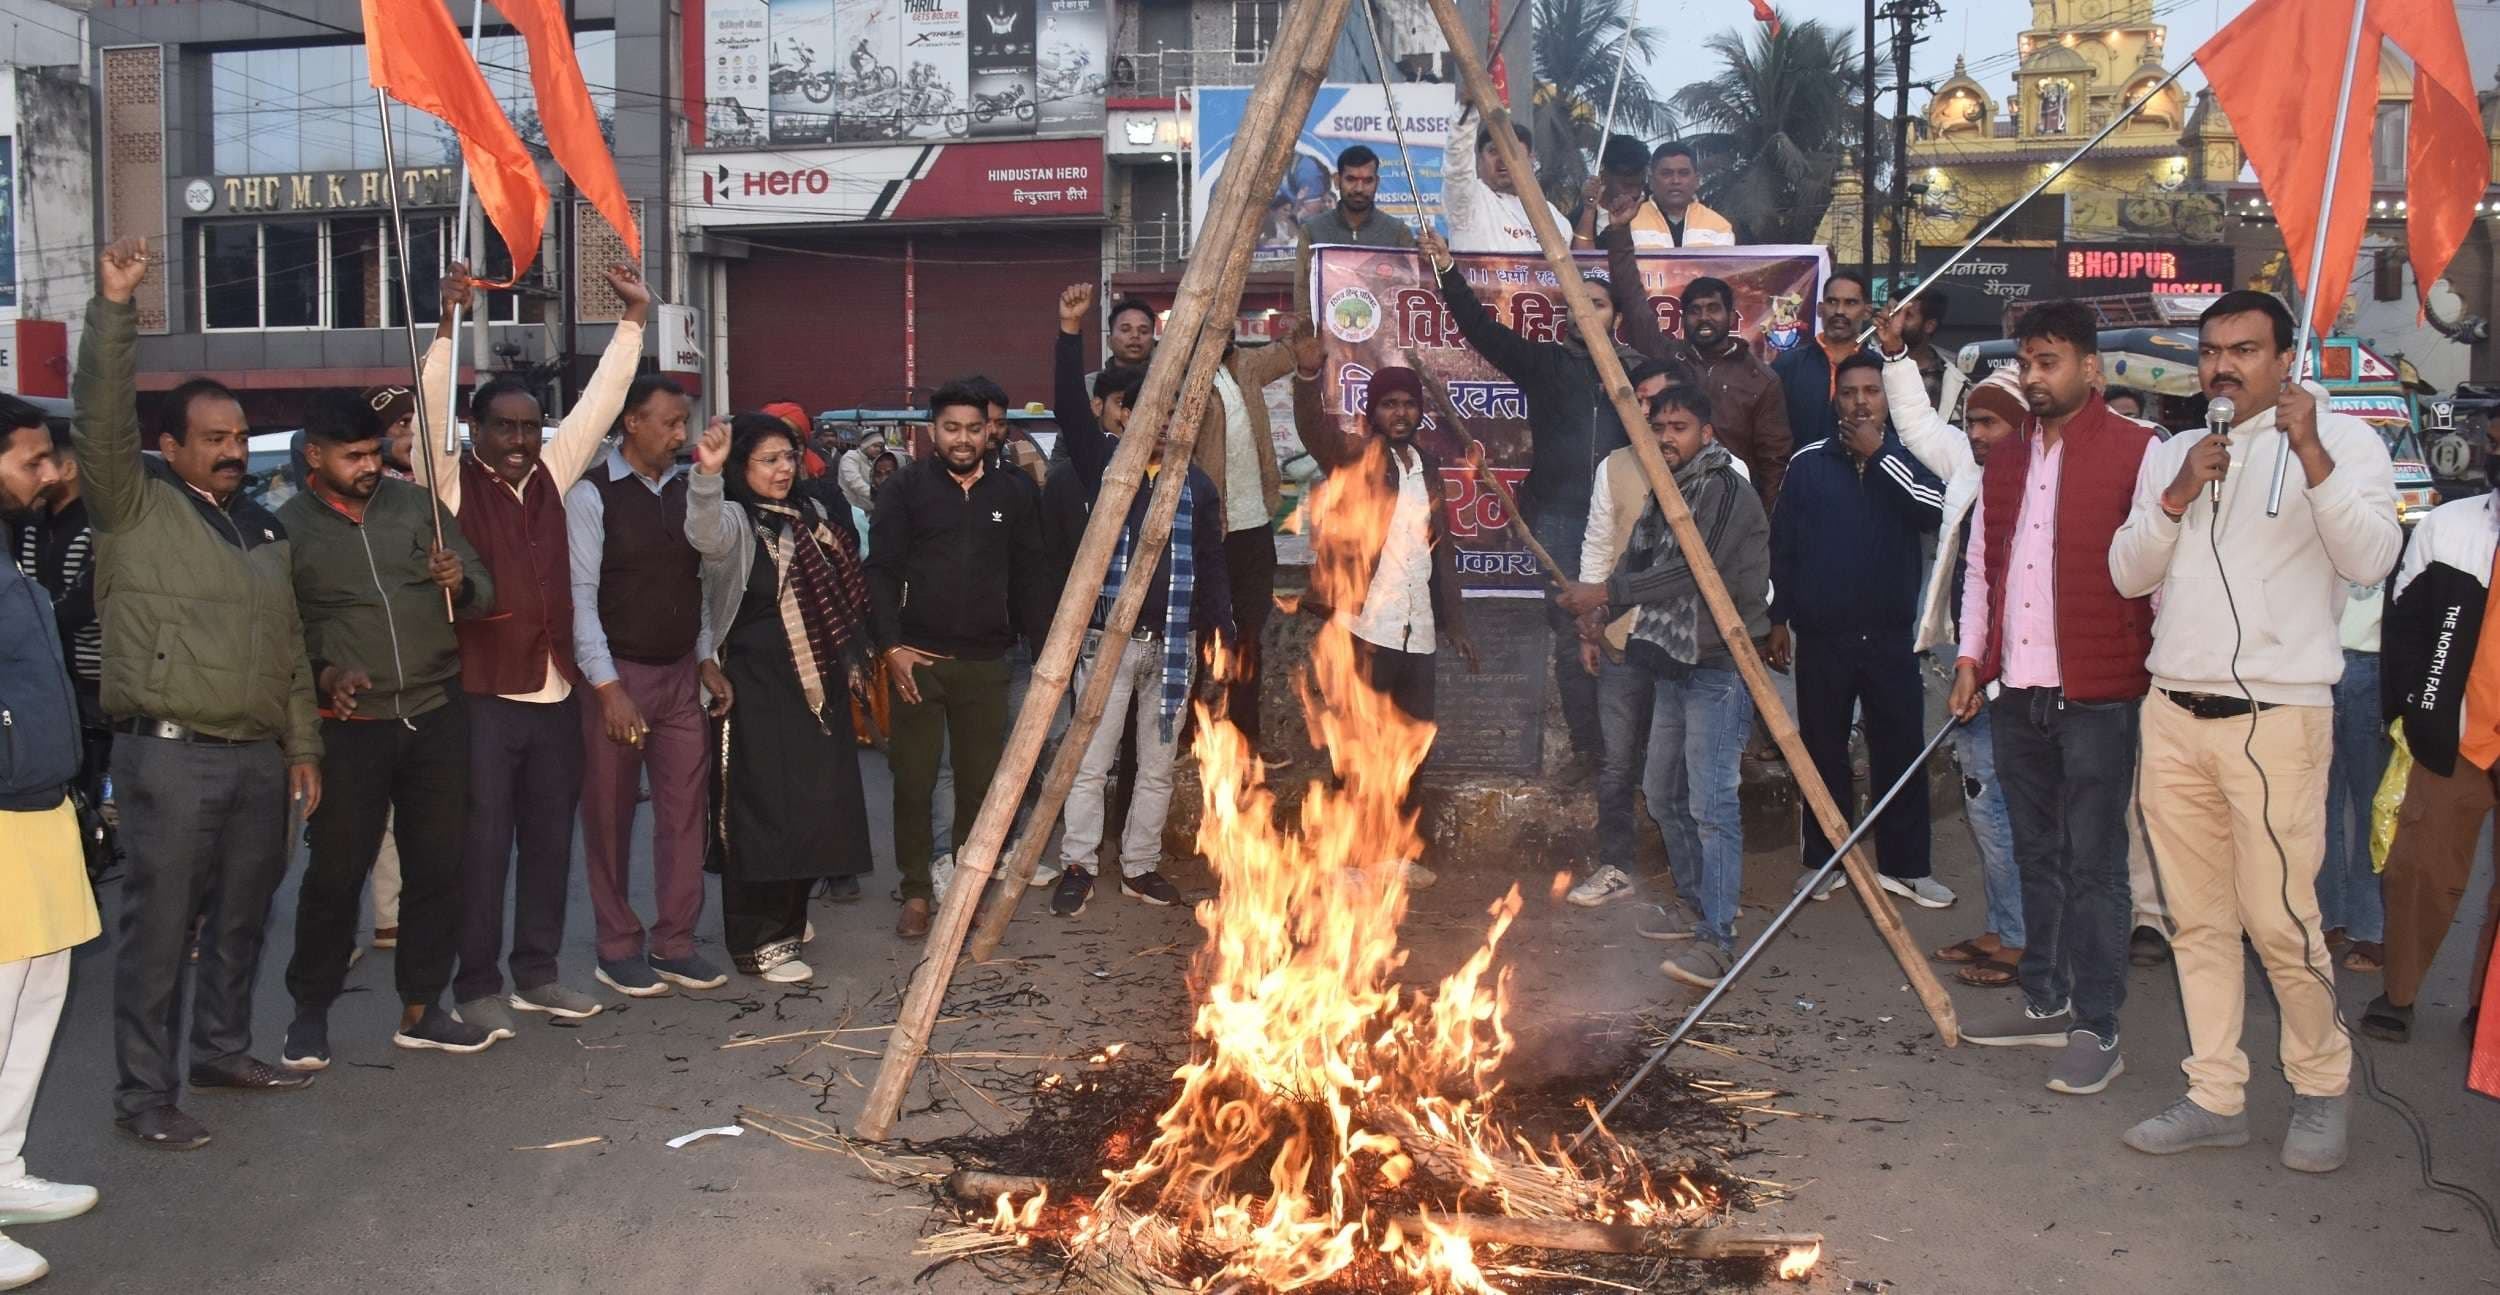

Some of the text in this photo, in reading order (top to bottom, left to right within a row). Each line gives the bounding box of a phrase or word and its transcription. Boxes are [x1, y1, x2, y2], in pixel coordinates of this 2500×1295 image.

[1333, 116, 1382, 132] SCOPE
[744, 169, 829, 196] Hero
[988, 167, 1088, 181] HINDUSTAN HERO
[224, 178, 281, 212] THE
[1067, 187, 1088, 201] हीरो
[2068, 251, 2176, 279] BHOJPUR
[2420, 605, 2462, 711] THE NORTH FACE
